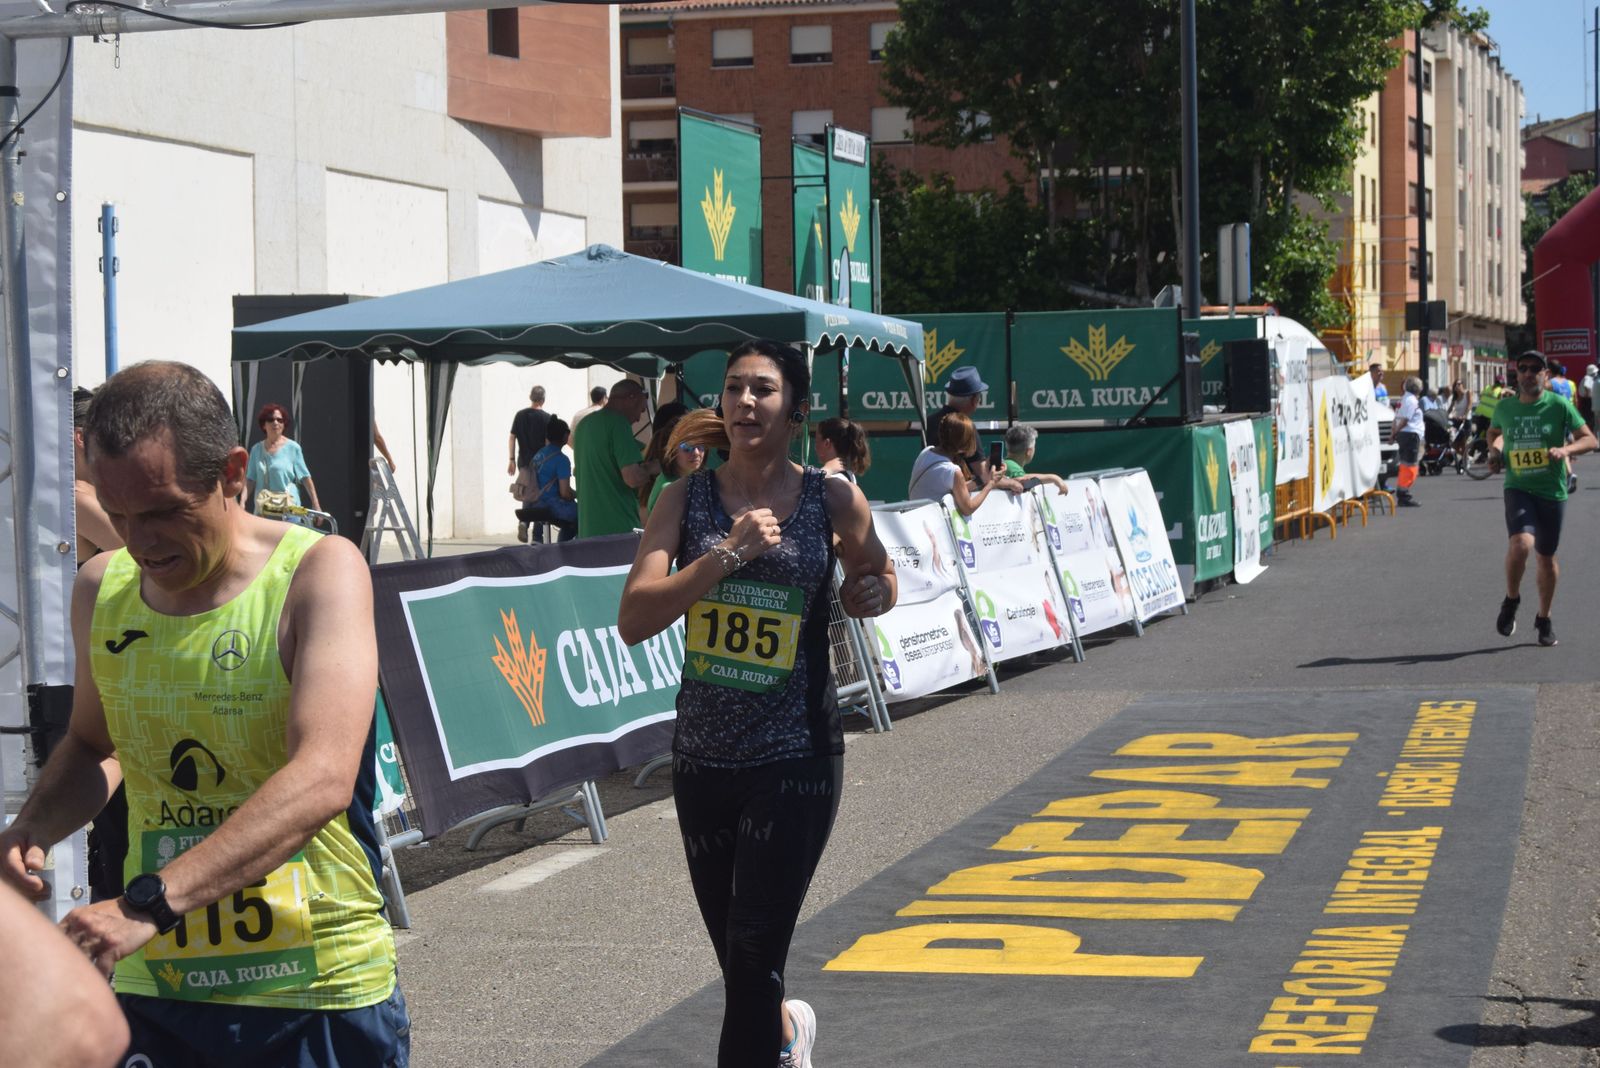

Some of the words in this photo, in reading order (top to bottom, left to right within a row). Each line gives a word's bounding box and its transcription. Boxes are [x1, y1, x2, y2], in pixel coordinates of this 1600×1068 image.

[861, 391, 915, 410] CAJA
[1031, 388, 1086, 408] CAJA
[1091, 386, 1169, 407] RURAL
[1514, 450, 1544, 467] 148
[721, 593, 748, 605] CAJA
[750, 596, 788, 611] RURAL
[722, 583, 790, 601] FUNDACION
[701, 608, 782, 660] 185
[556, 624, 648, 707] CAJA
[711, 664, 738, 680] CAJA
[740, 670, 780, 686] RURAL
[194, 691, 264, 702] Mercedes-Benz
[212, 705, 244, 716] Adarsa
[821, 731, 1360, 978] PIDEPAR
[1322, 826, 1444, 915] INTEGRAL
[186, 970, 233, 989] CAJA
[235, 960, 307, 982] RURAL
[1247, 924, 1411, 1055] REFORMA
